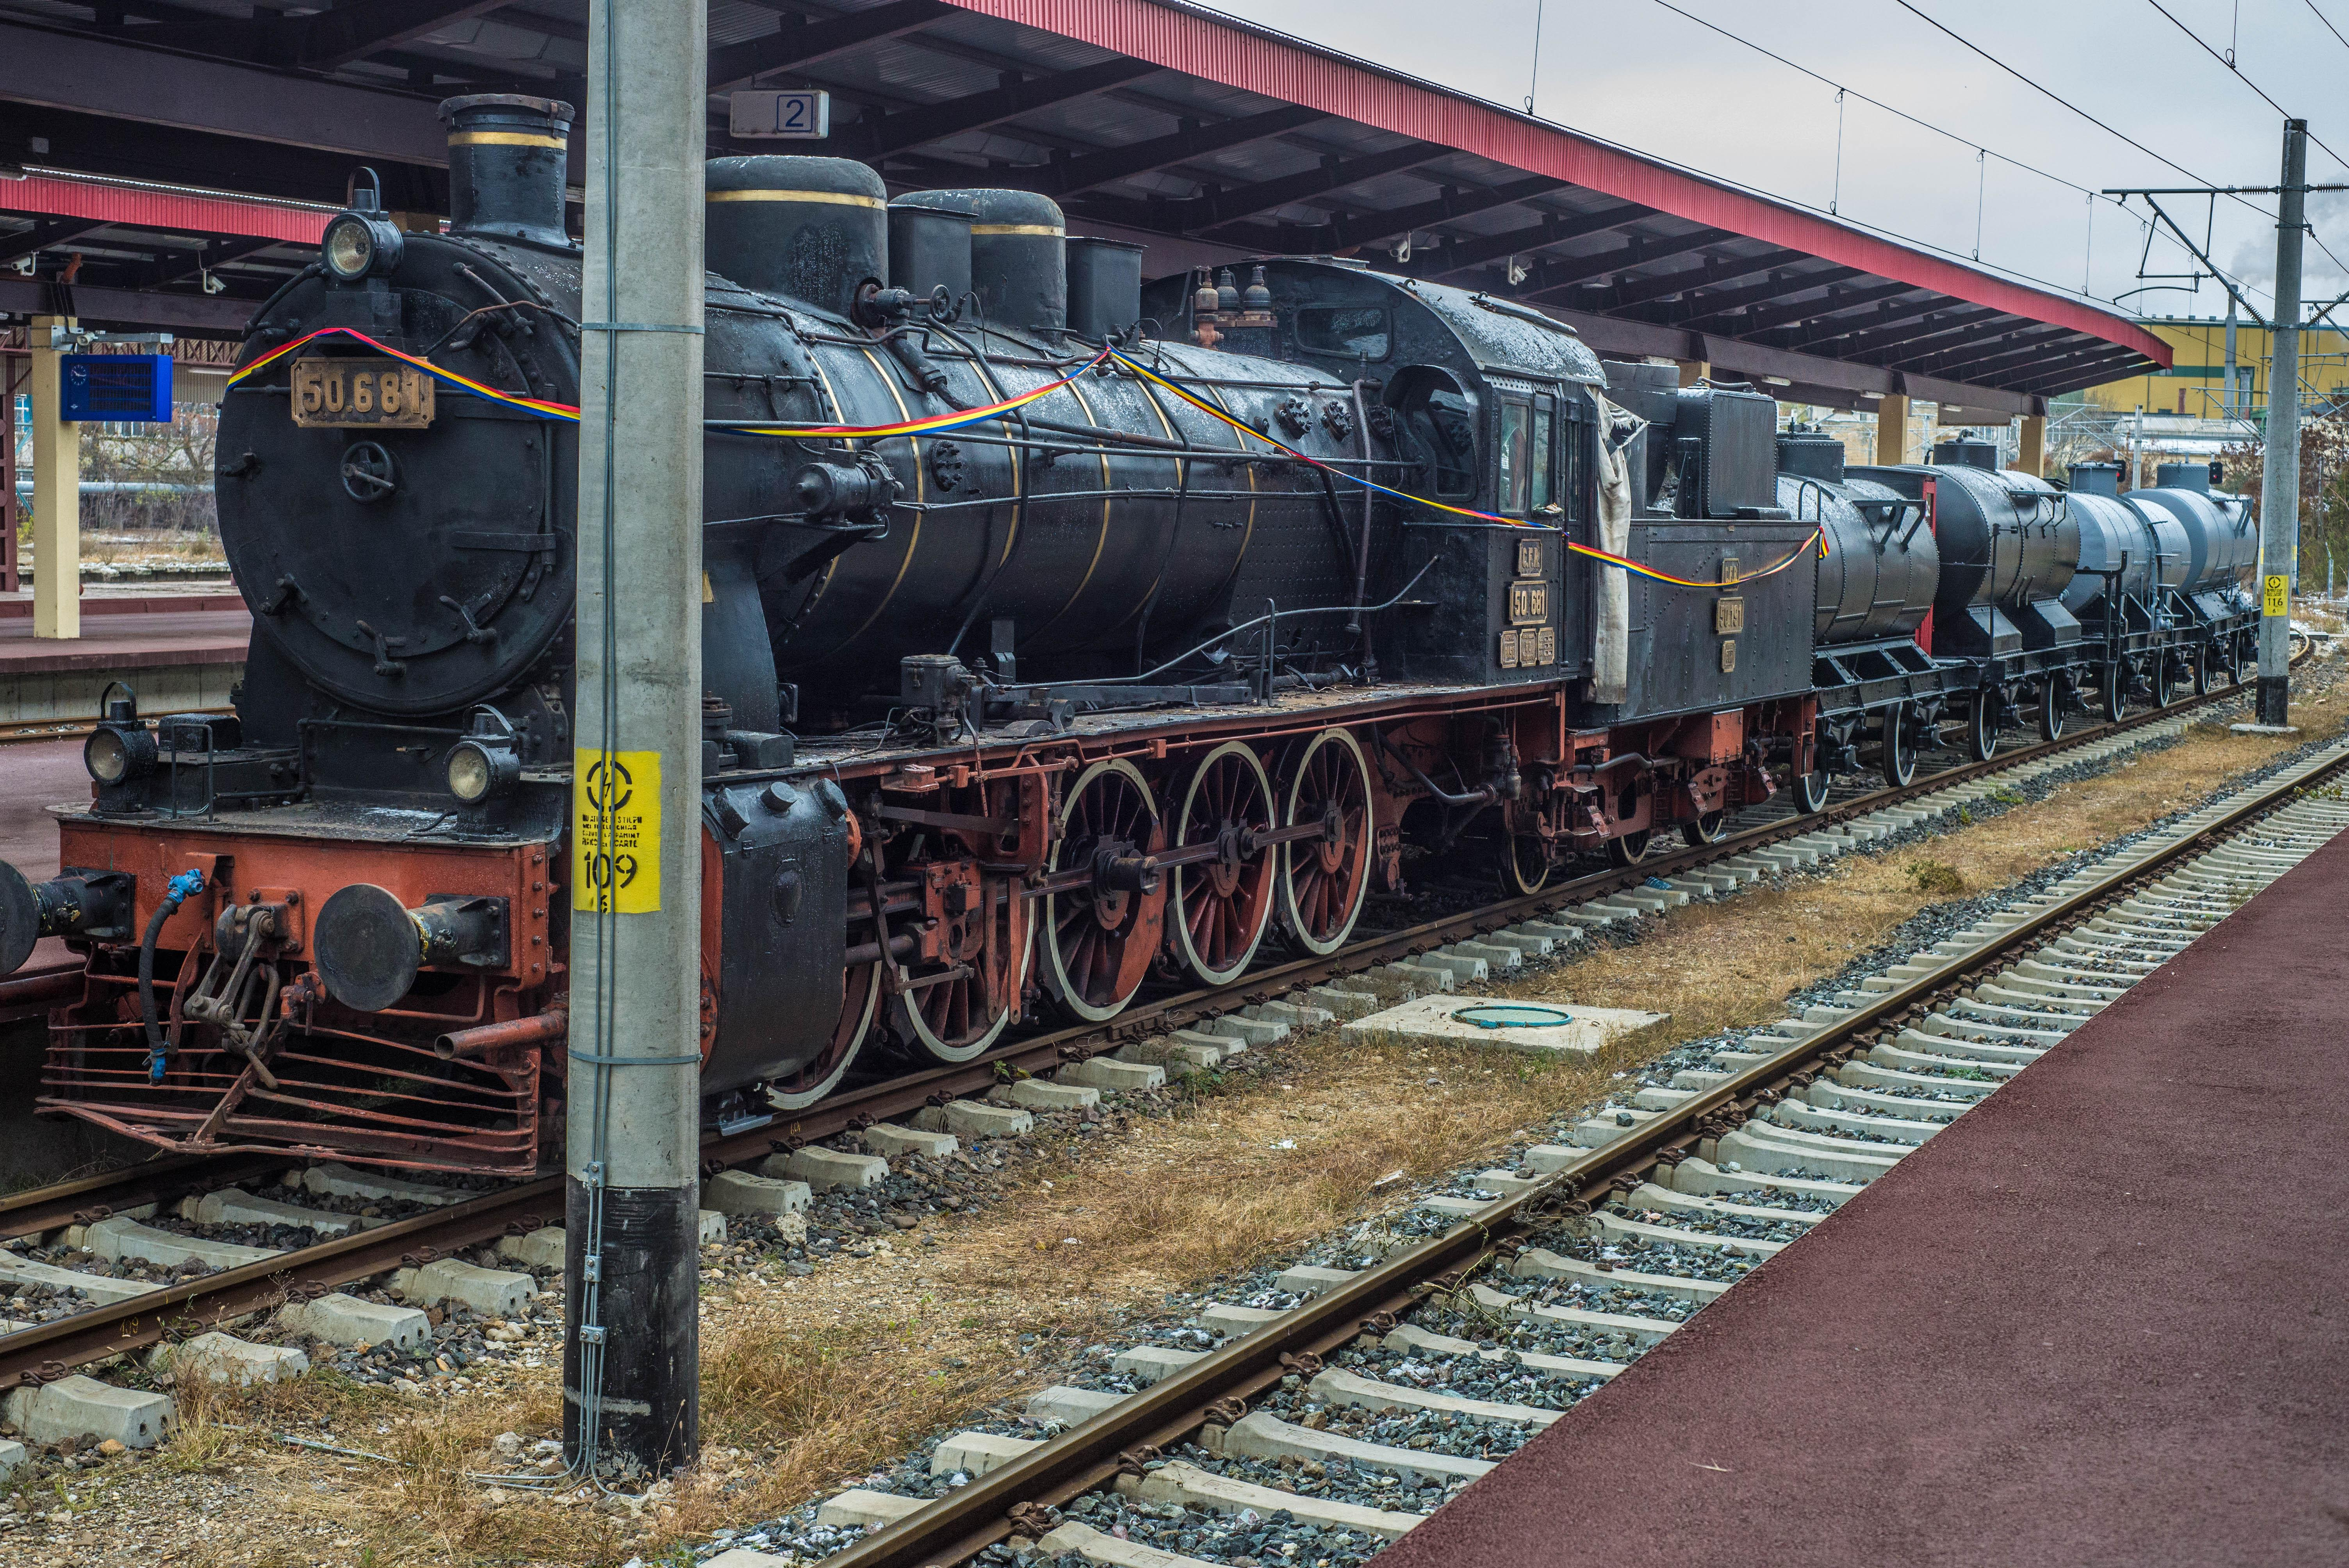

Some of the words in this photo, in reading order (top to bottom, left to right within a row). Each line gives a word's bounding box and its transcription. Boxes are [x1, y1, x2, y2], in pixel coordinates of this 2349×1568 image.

[785, 99, 804, 127] 2
[302, 372, 421, 414] 50.681
[2268, 598, 2283, 606] 116
[584, 852, 637, 889] 109
